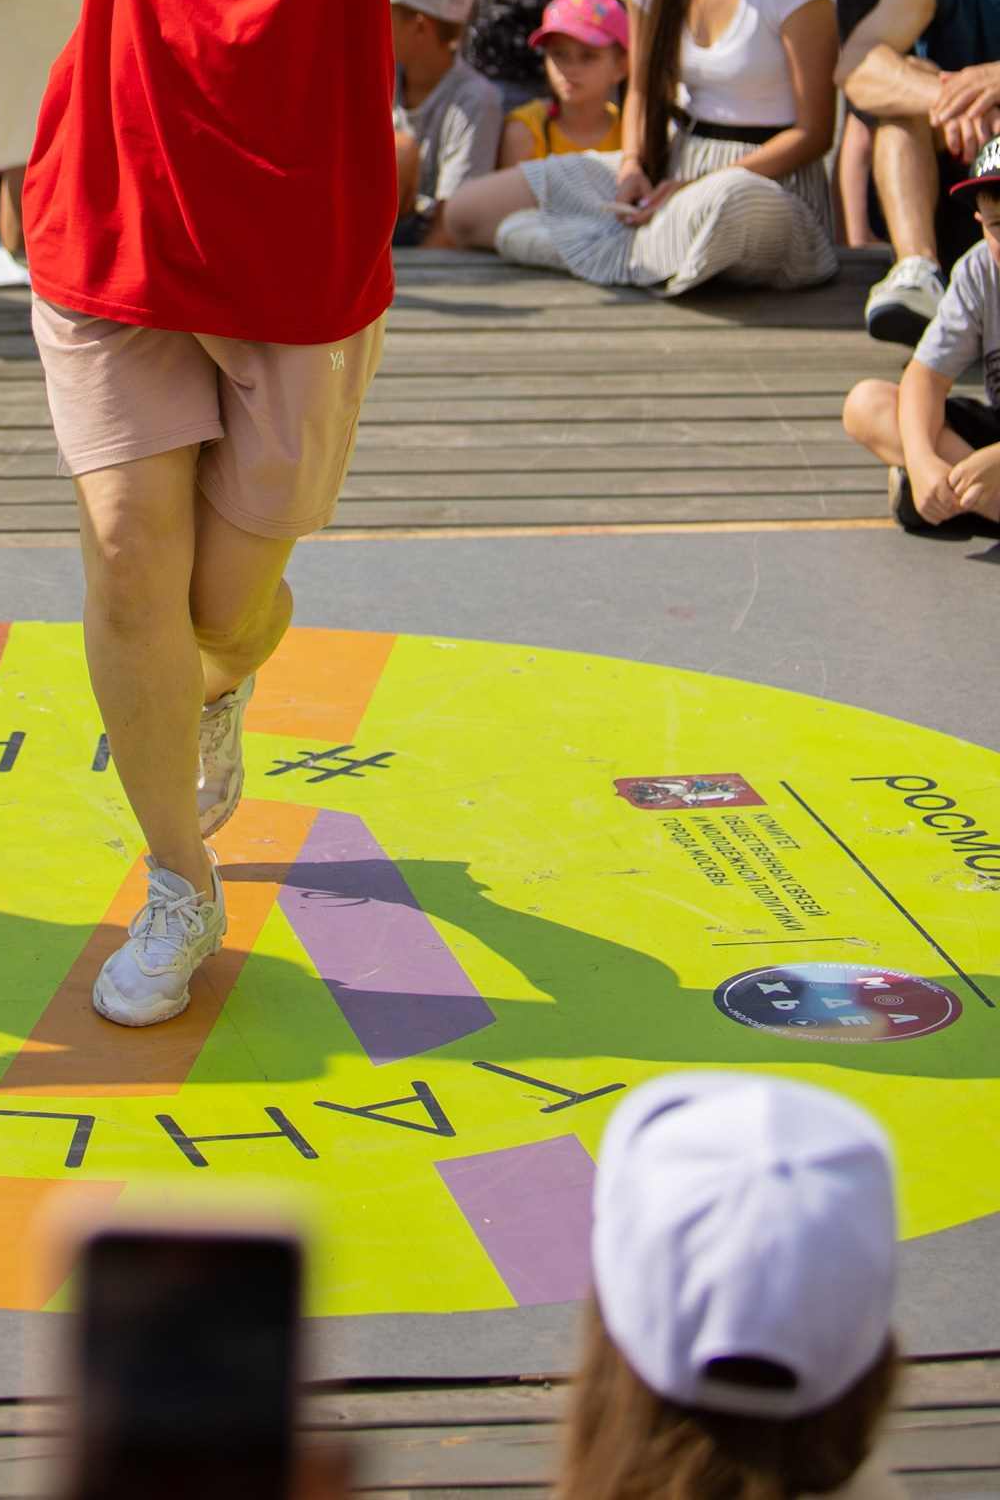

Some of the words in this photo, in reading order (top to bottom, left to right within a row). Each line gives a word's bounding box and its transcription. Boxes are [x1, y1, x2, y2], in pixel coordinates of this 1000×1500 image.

[657, 817, 699, 849] ГОРОДА
[686, 849, 733, 886] МОСКВЫ
[720, 814, 796, 883] ОБЩЕСТВЕННЫХ
[782, 883, 831, 918] СВЯЗЕЙ
[751, 813, 801, 850] КОМИТЕТ
[689, 815, 713, 824] И
[748, 883, 807, 932] ПОЛИТИКИ
[817, 962, 911, 980] ПРОЕКТНЫЙ
[912, 977, 946, 995] ОФИС
